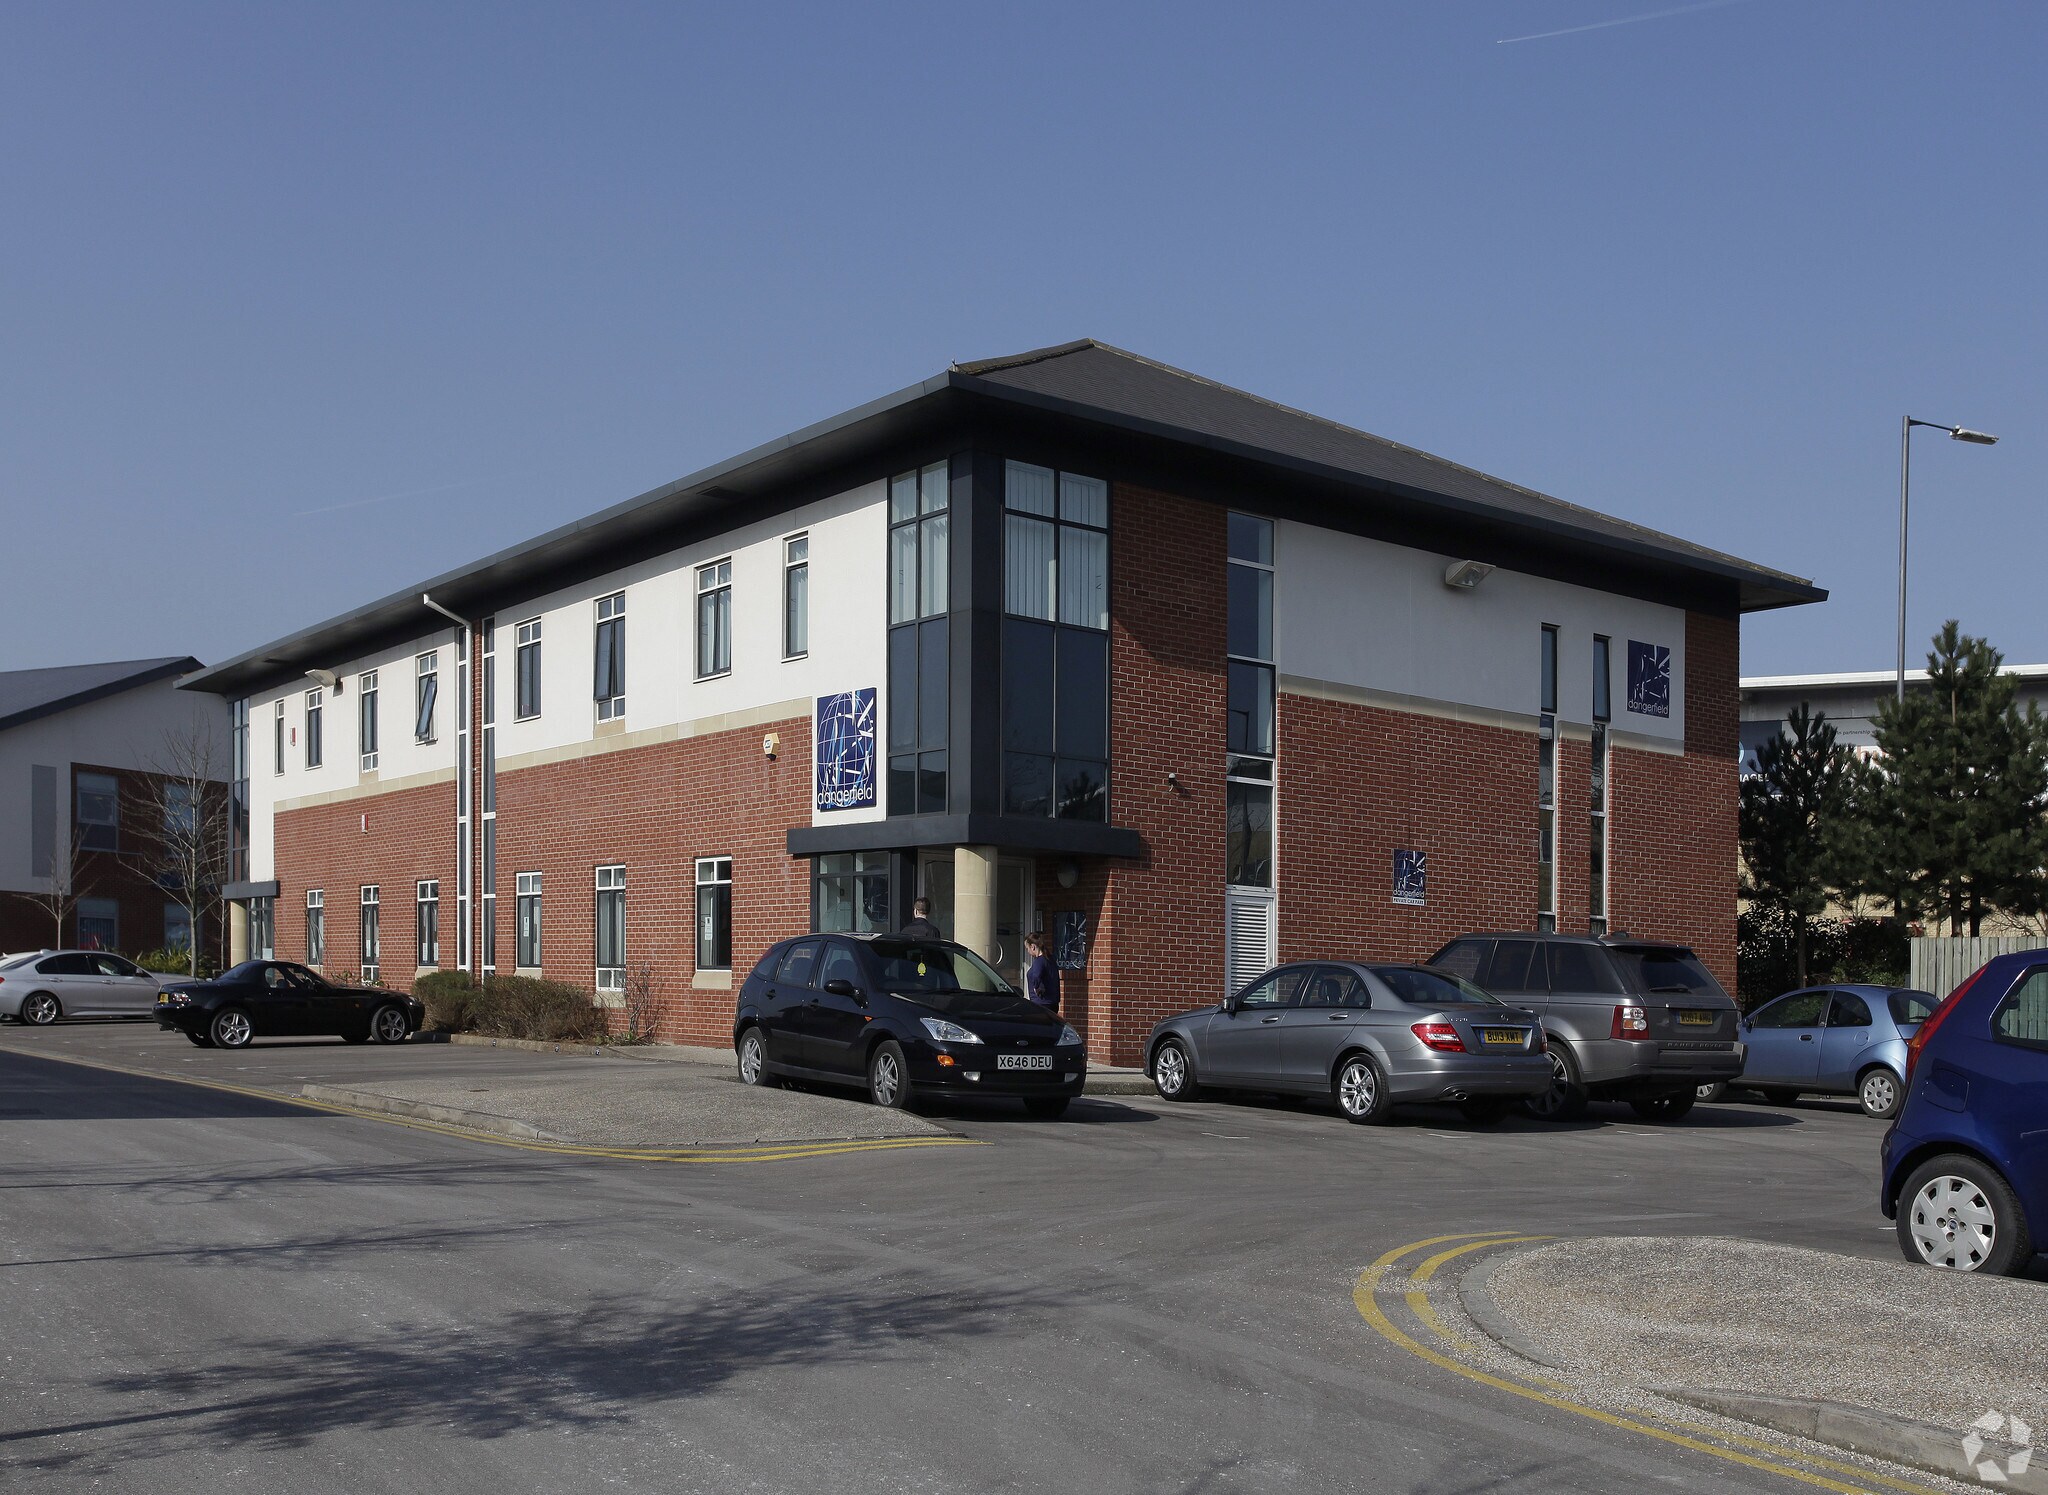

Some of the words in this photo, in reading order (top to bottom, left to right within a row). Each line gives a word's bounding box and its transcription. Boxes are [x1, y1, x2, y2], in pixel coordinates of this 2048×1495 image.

[1628, 699, 1669, 715] dangerfield
[817, 783, 873, 806] dangerfield
[1487, 1031, 1504, 1041] BU13
[1000, 1056, 1028, 1068] X646
[1031, 1056, 1051, 1068] DEU
